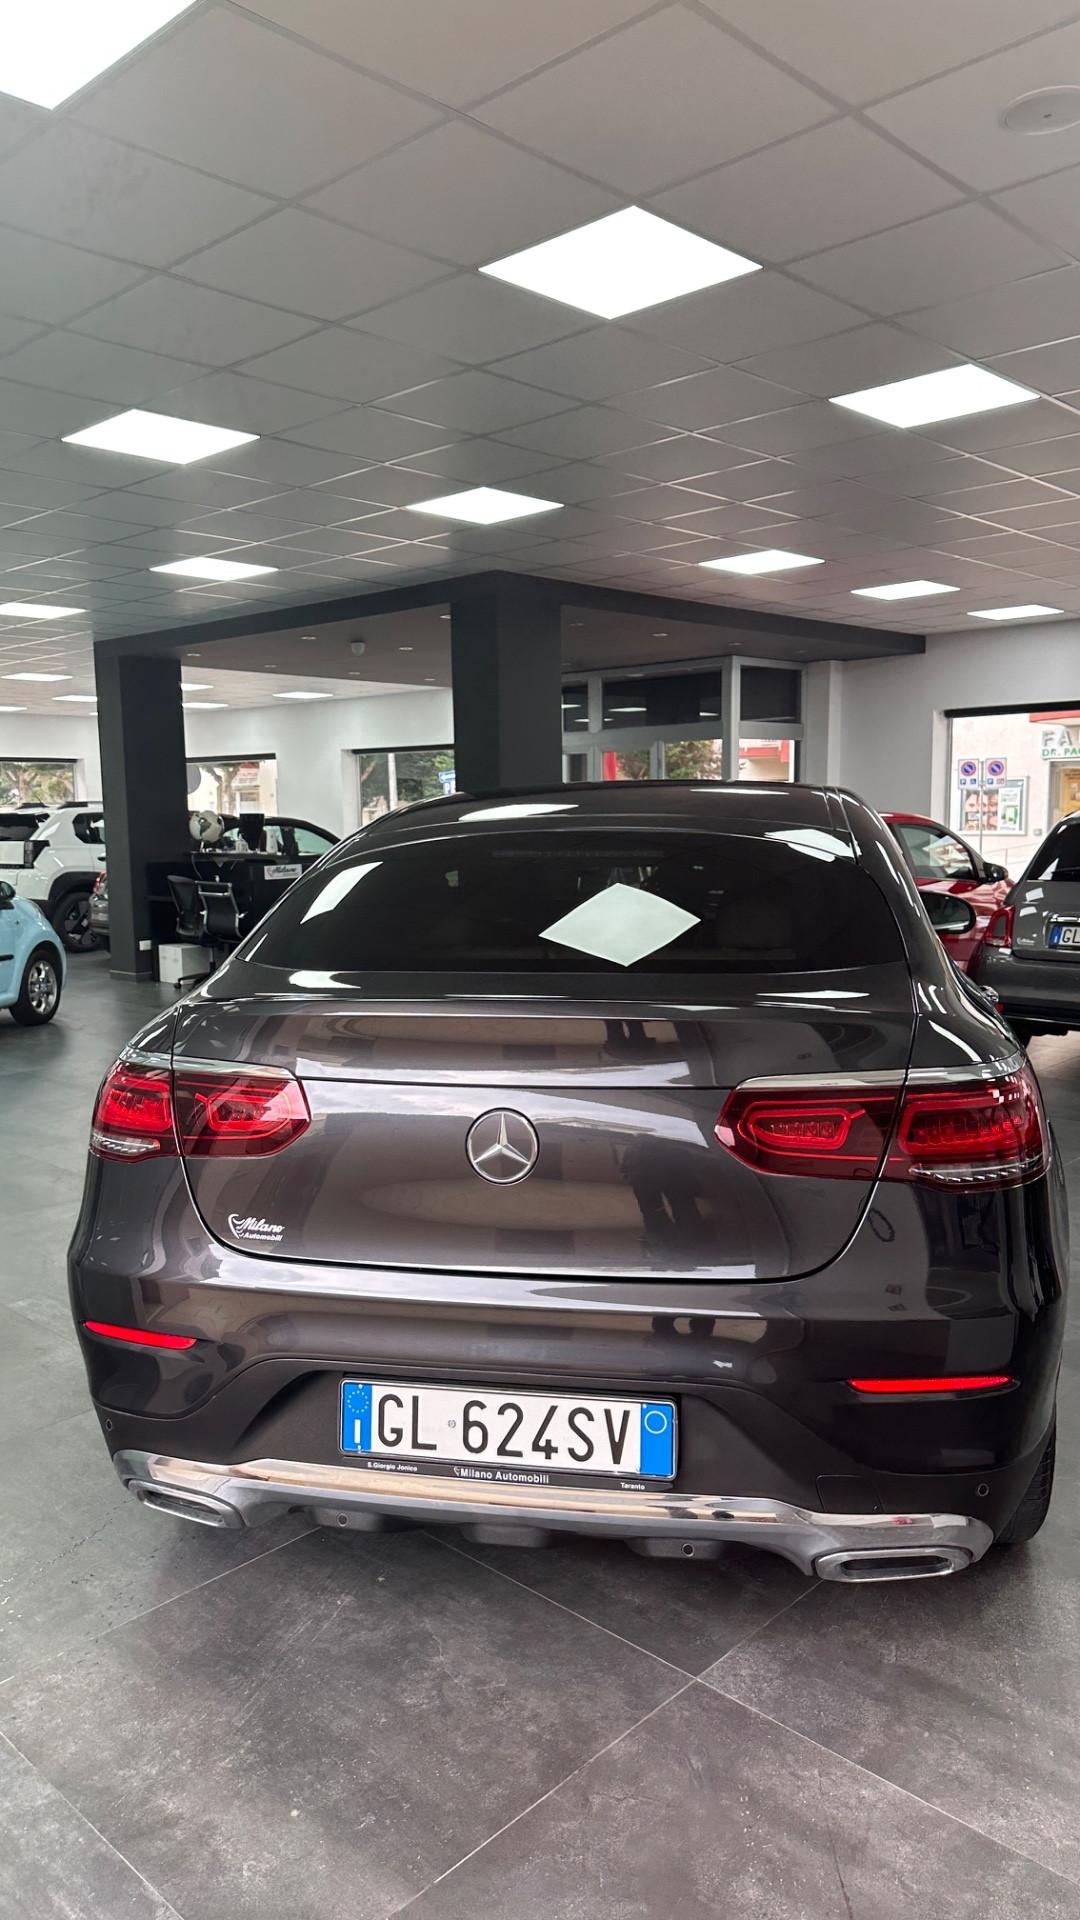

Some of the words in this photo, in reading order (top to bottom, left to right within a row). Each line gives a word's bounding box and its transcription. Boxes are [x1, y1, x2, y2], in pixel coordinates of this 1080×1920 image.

[243, 1217, 285, 1233] Milano
[243, 1232, 284, 1242] Automobili
[378, 1393, 438, 1451] GL
[462, 1400, 631, 1465] 624SV
[396, 1464, 418, 1472] Jonico
[460, 1468, 493, 1479] Milano
[495, 1471, 549, 1484] Automobili
[620, 1482, 646, 1490] Taranto
